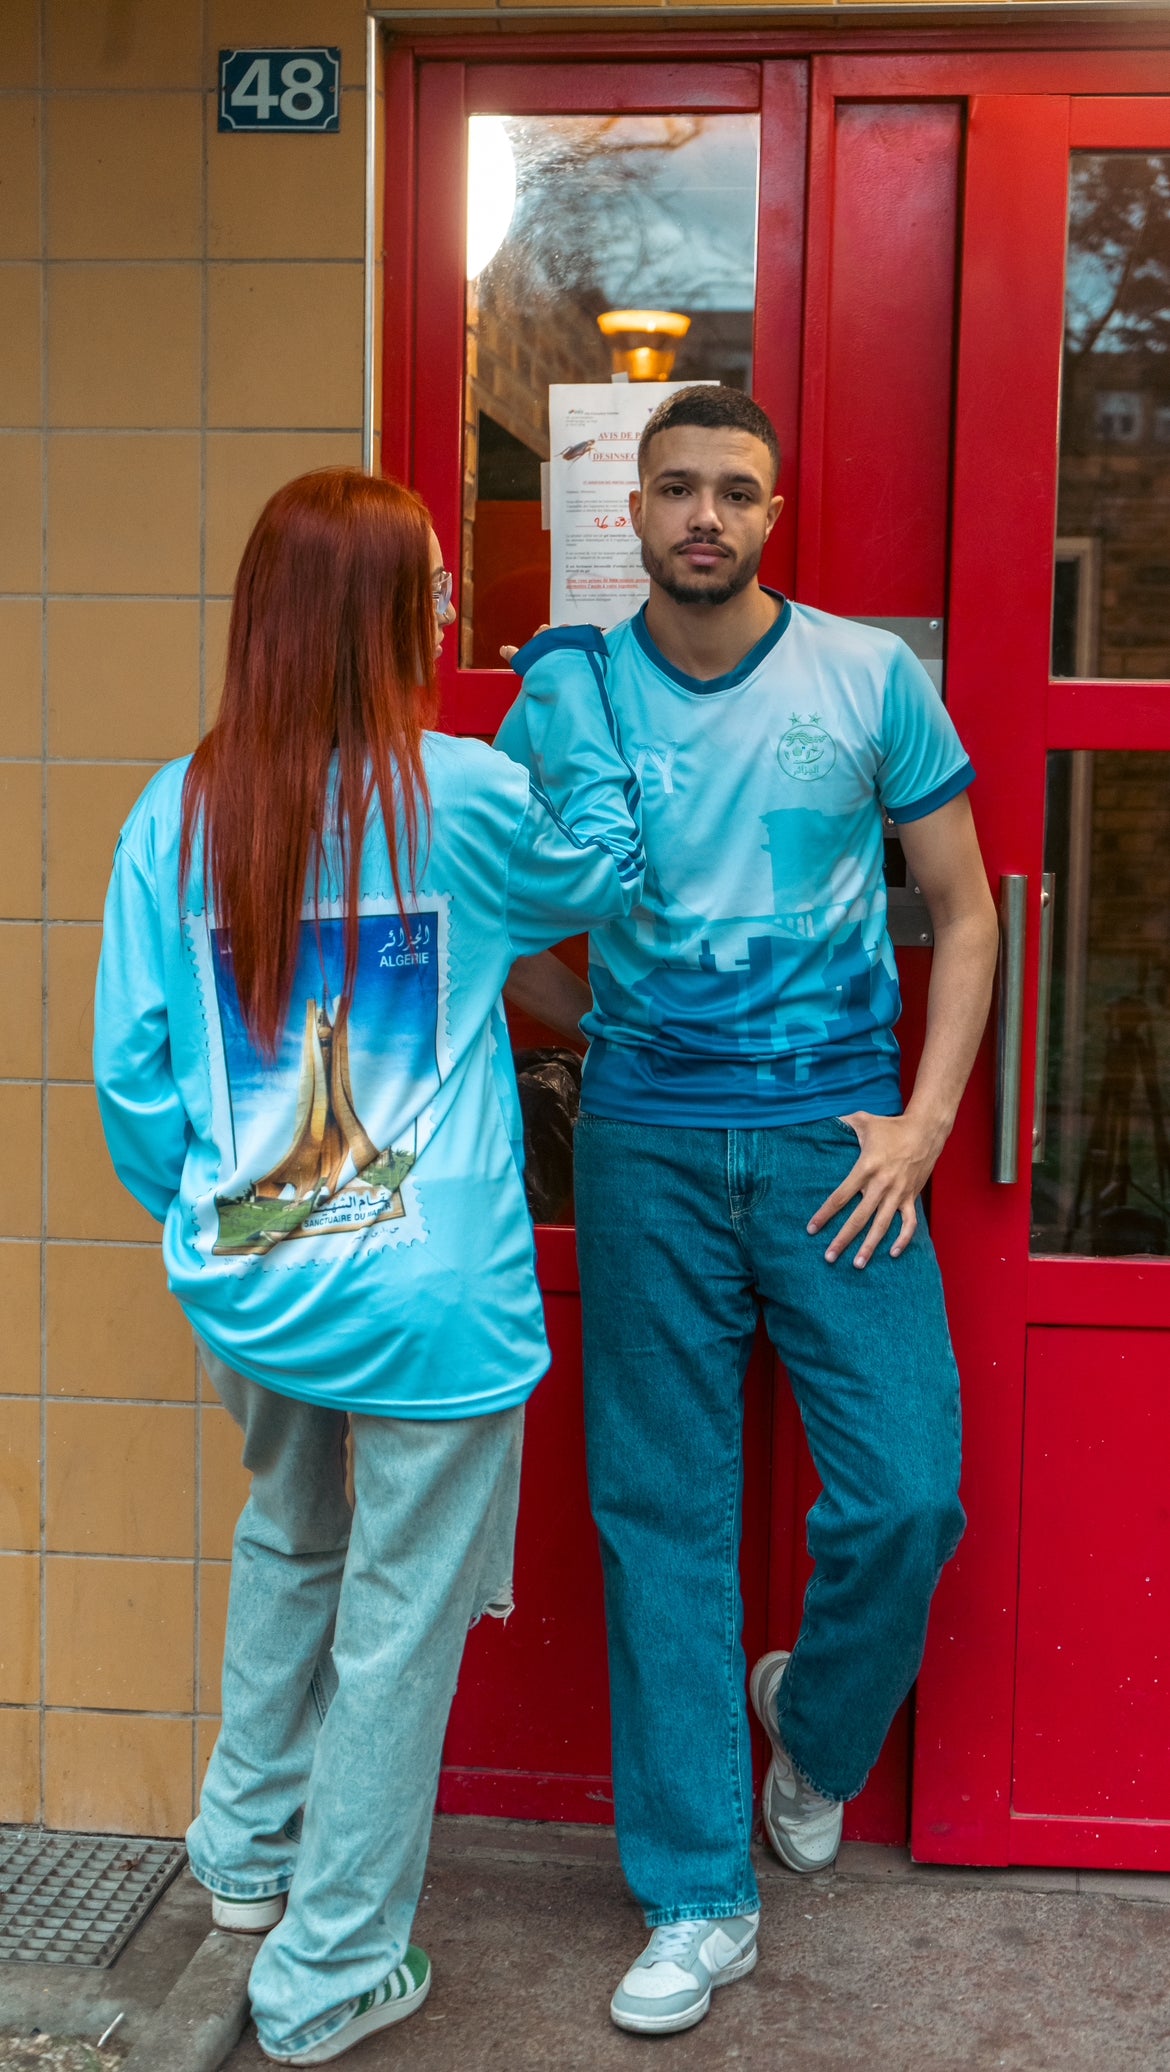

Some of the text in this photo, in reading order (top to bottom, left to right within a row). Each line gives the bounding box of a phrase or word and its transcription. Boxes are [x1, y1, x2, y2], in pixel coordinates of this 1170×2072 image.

[231, 58, 324, 121] 48
[599, 432, 618, 440] AVIS
[620, 432, 632, 440] DE
[592, 452, 639, 460] DESINSEC
[377, 923, 430, 953] الجزائر
[379, 952, 430, 968] ALGERIE
[304, 1213, 353, 1228] SANCTUAIRE
[354, 1213, 366, 1221] DU
